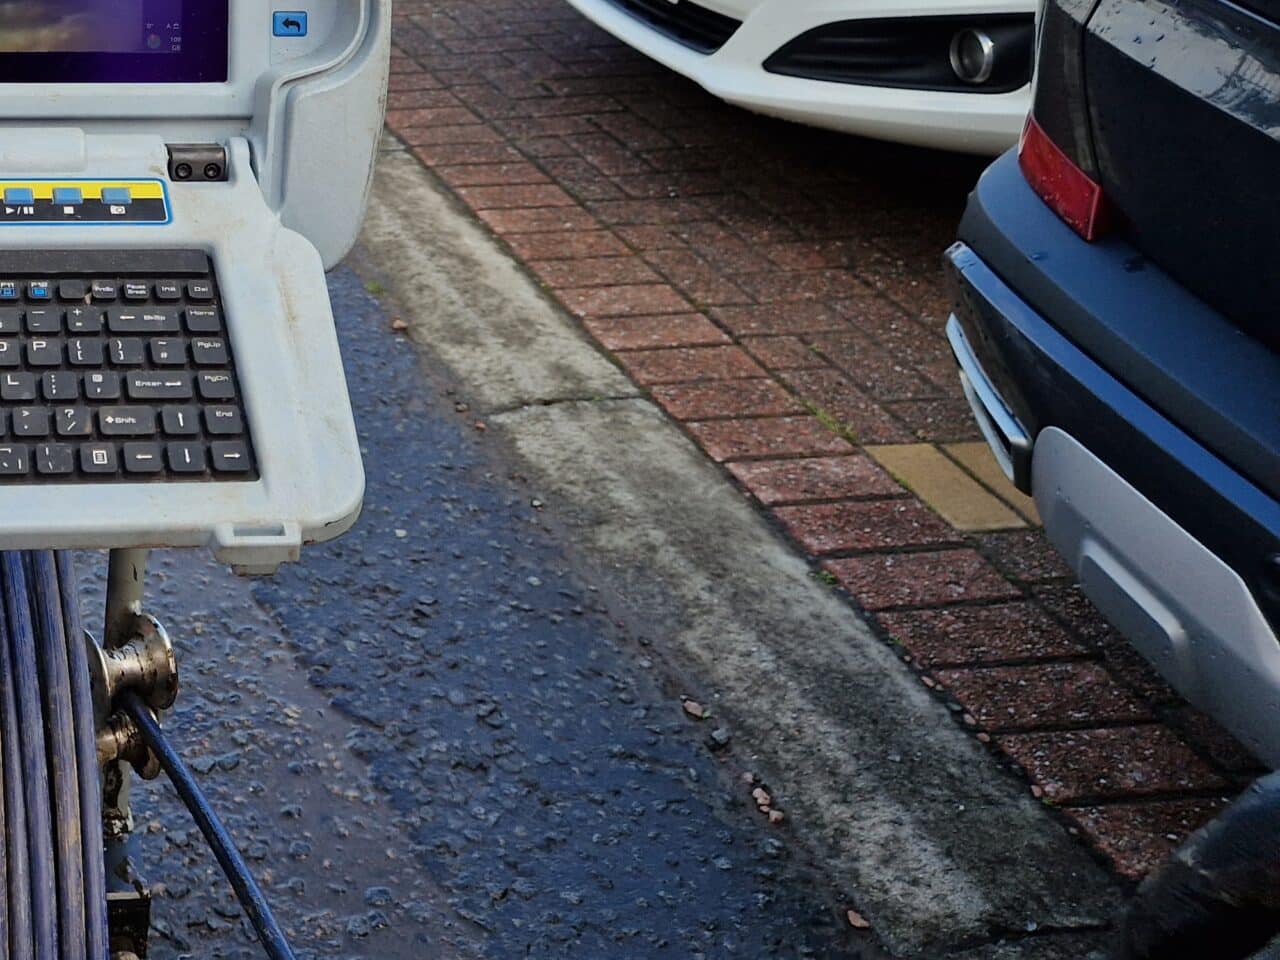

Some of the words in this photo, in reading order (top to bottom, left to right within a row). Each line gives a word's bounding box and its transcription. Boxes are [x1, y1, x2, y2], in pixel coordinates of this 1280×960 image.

[32, 340, 47, 352] P
[6, 373, 20, 386] L
[64, 408, 75, 419] ?
[215, 410, 233, 418] End
[114, 416, 137, 424] Shift
